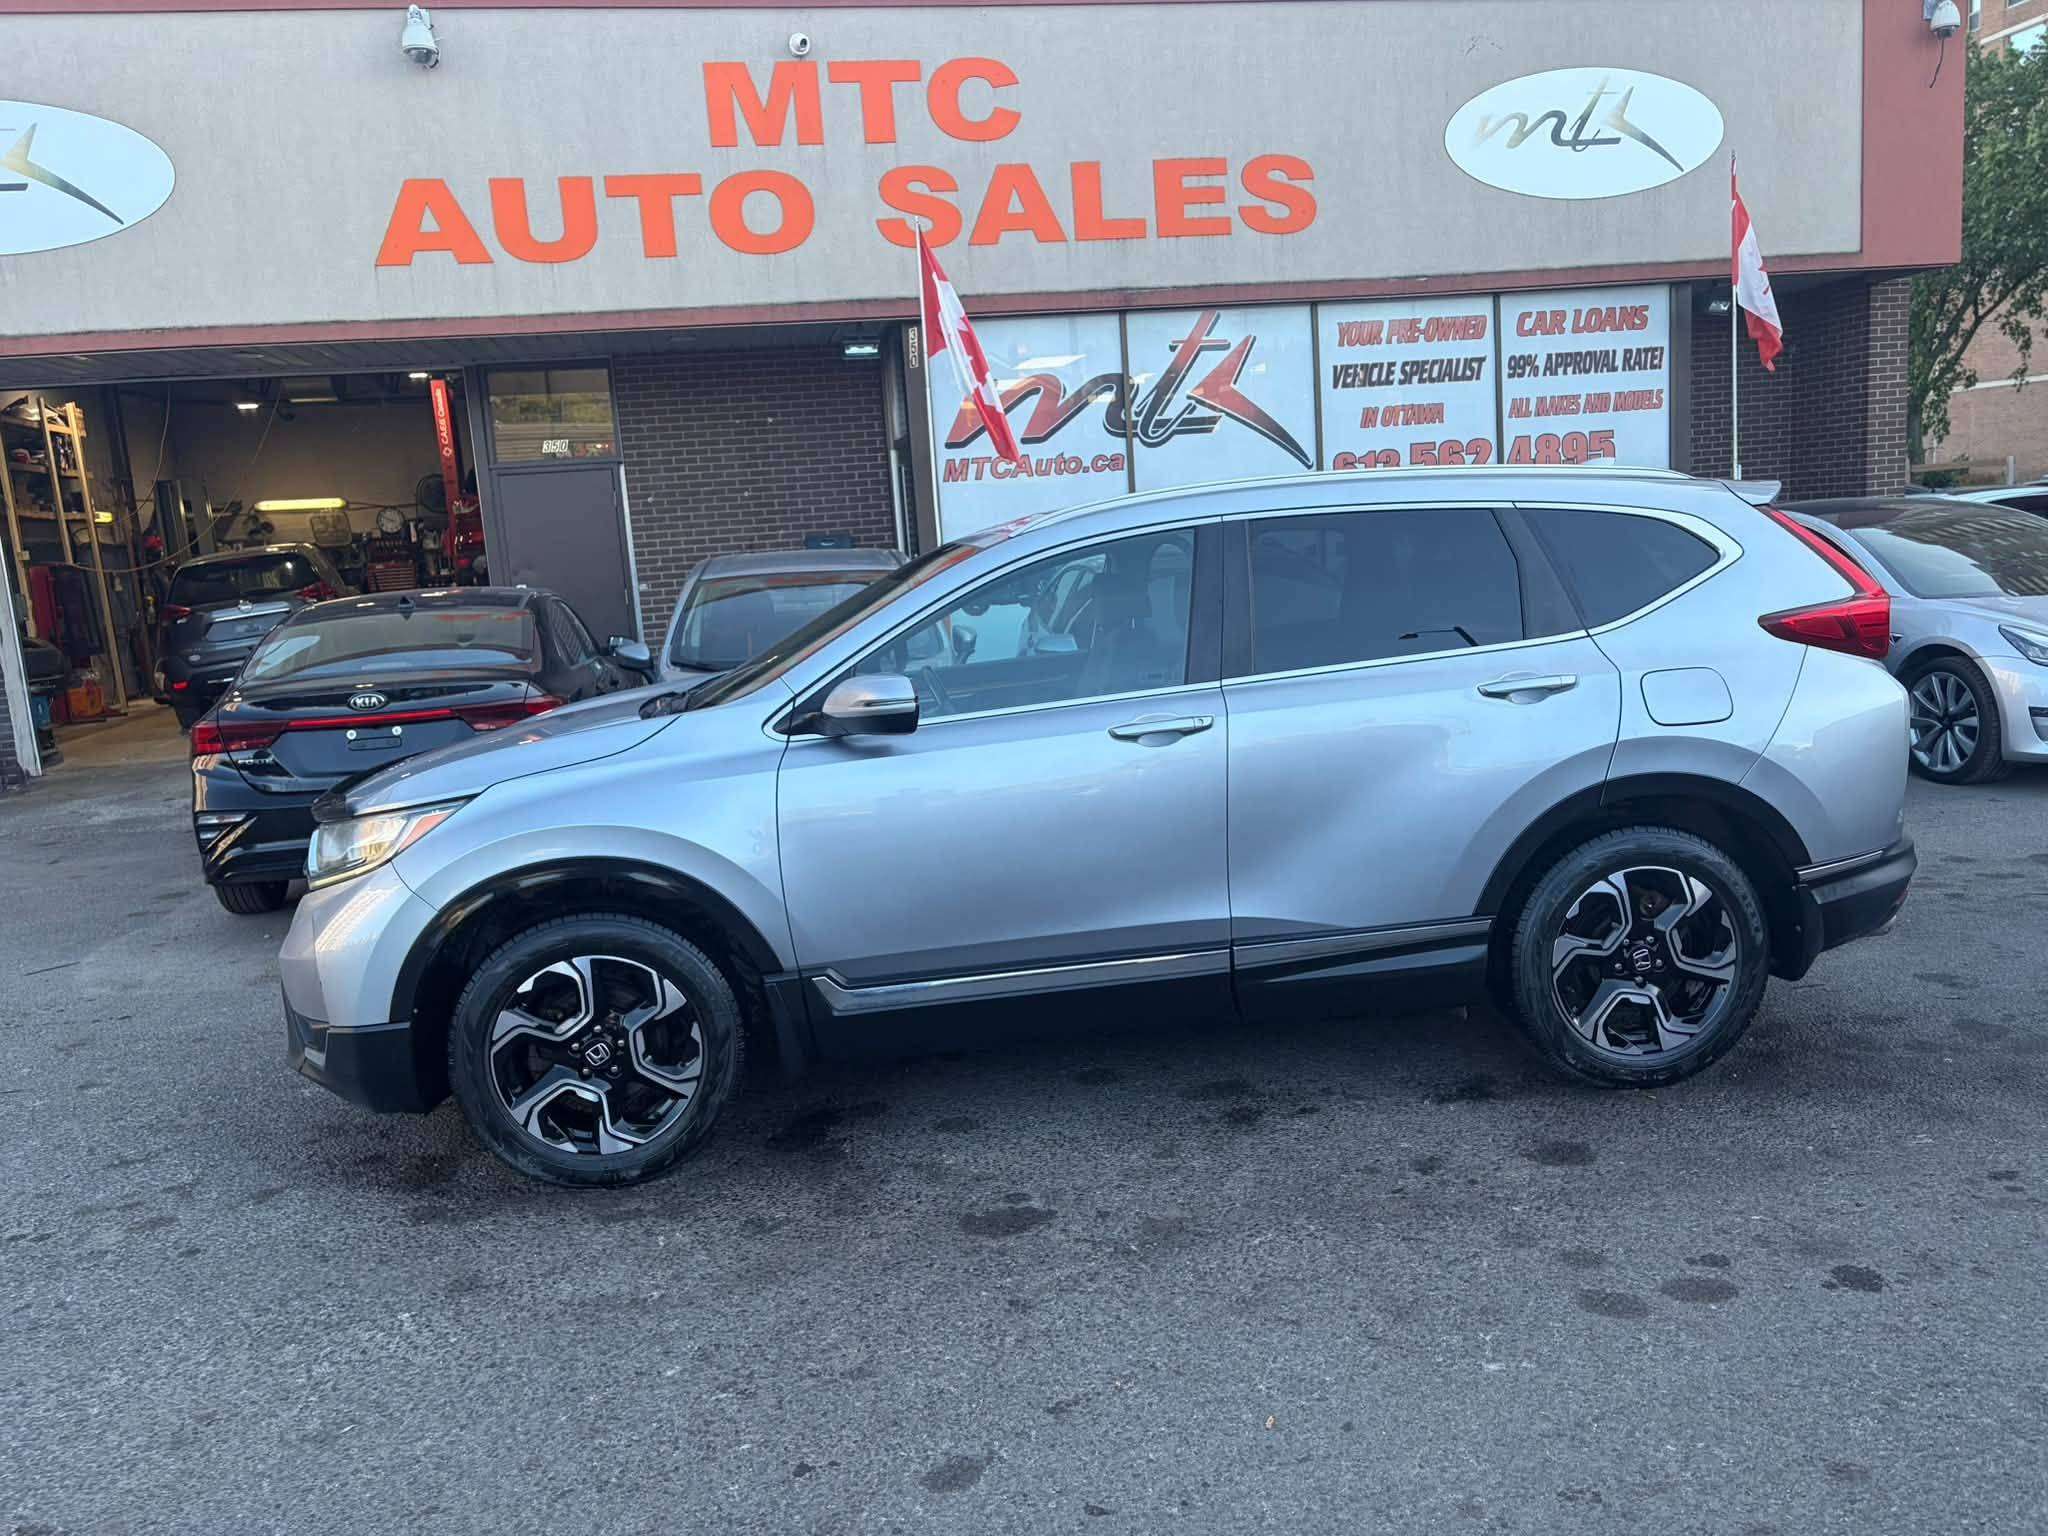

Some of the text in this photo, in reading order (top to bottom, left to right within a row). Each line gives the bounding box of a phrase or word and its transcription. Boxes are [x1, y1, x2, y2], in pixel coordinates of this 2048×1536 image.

[703, 57, 1021, 147] MTC
[376, 154, 1317, 266] AUTO SALES
[1337, 315, 1488, 347] YOUR PRE-OWNED
[1516, 305, 1649, 337] CAR LOANS
[1332, 355, 1487, 389] VEHICLE SPECIALIST
[1507, 346, 1664, 379] 99% APPROVAL RATE!
[1360, 402, 1444, 428] IN OTTAWA
[1508, 389, 1664, 418] ALL MAKES AND MODELS
[543, 440, 568, 453] 350
[1410, 437, 1493, 466] 562
[1506, 430, 1615, 465] 4895
[943, 451, 1126, 482] MTCAuto.ca
[356, 697, 379, 707] KIA
